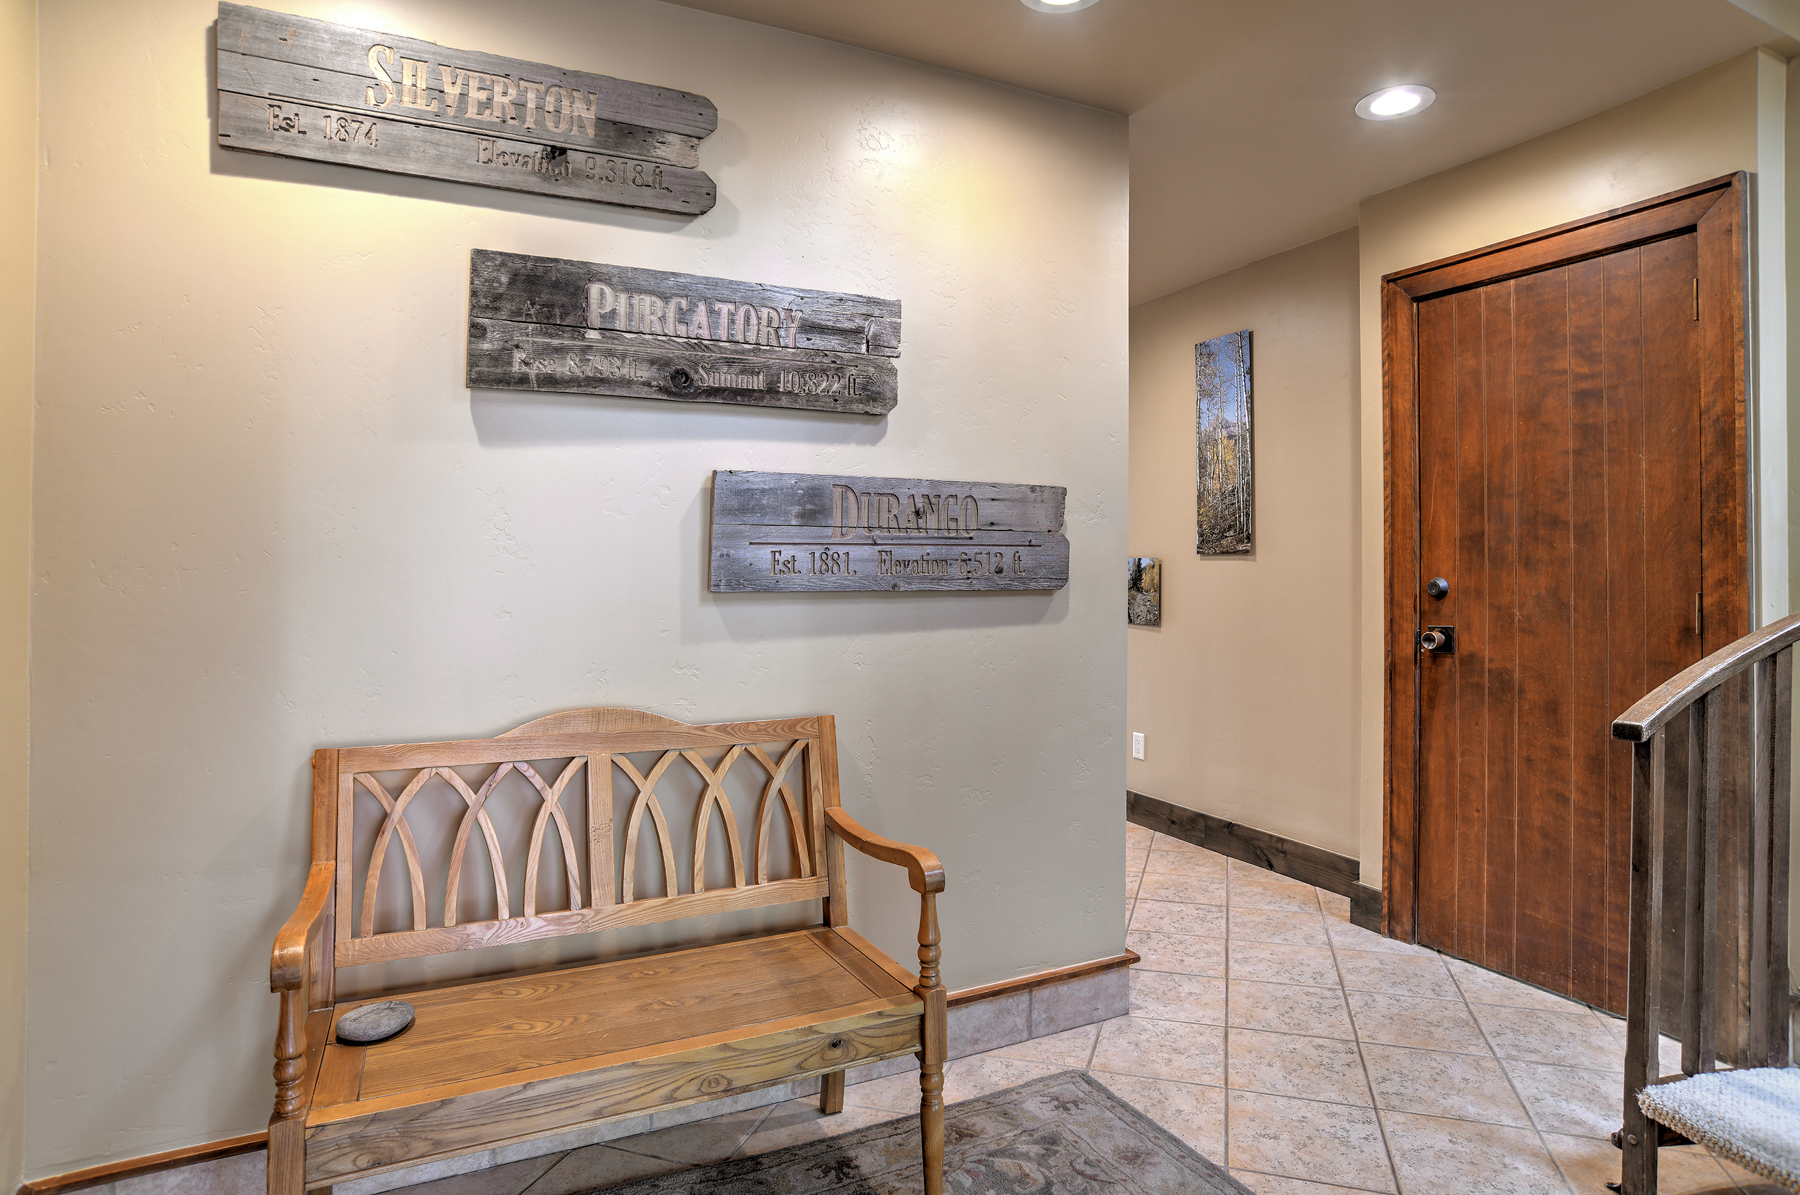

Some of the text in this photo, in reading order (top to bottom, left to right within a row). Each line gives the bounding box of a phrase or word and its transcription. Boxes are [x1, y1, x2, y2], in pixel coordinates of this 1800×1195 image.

[365, 43, 598, 138] SILVERTON
[266, 103, 307, 135] Est.
[323, 114, 379, 148] 1874
[583, 279, 804, 351] PURGATORY
[699, 360, 767, 391] Summit
[777, 369, 842, 396] 10,822
[846, 373, 863, 397] ft.
[830, 483, 979, 540] DURANGO
[769, 549, 802, 576] Est.
[876, 549, 949, 576] Elevation
[1011, 550, 1027, 576] ft.
